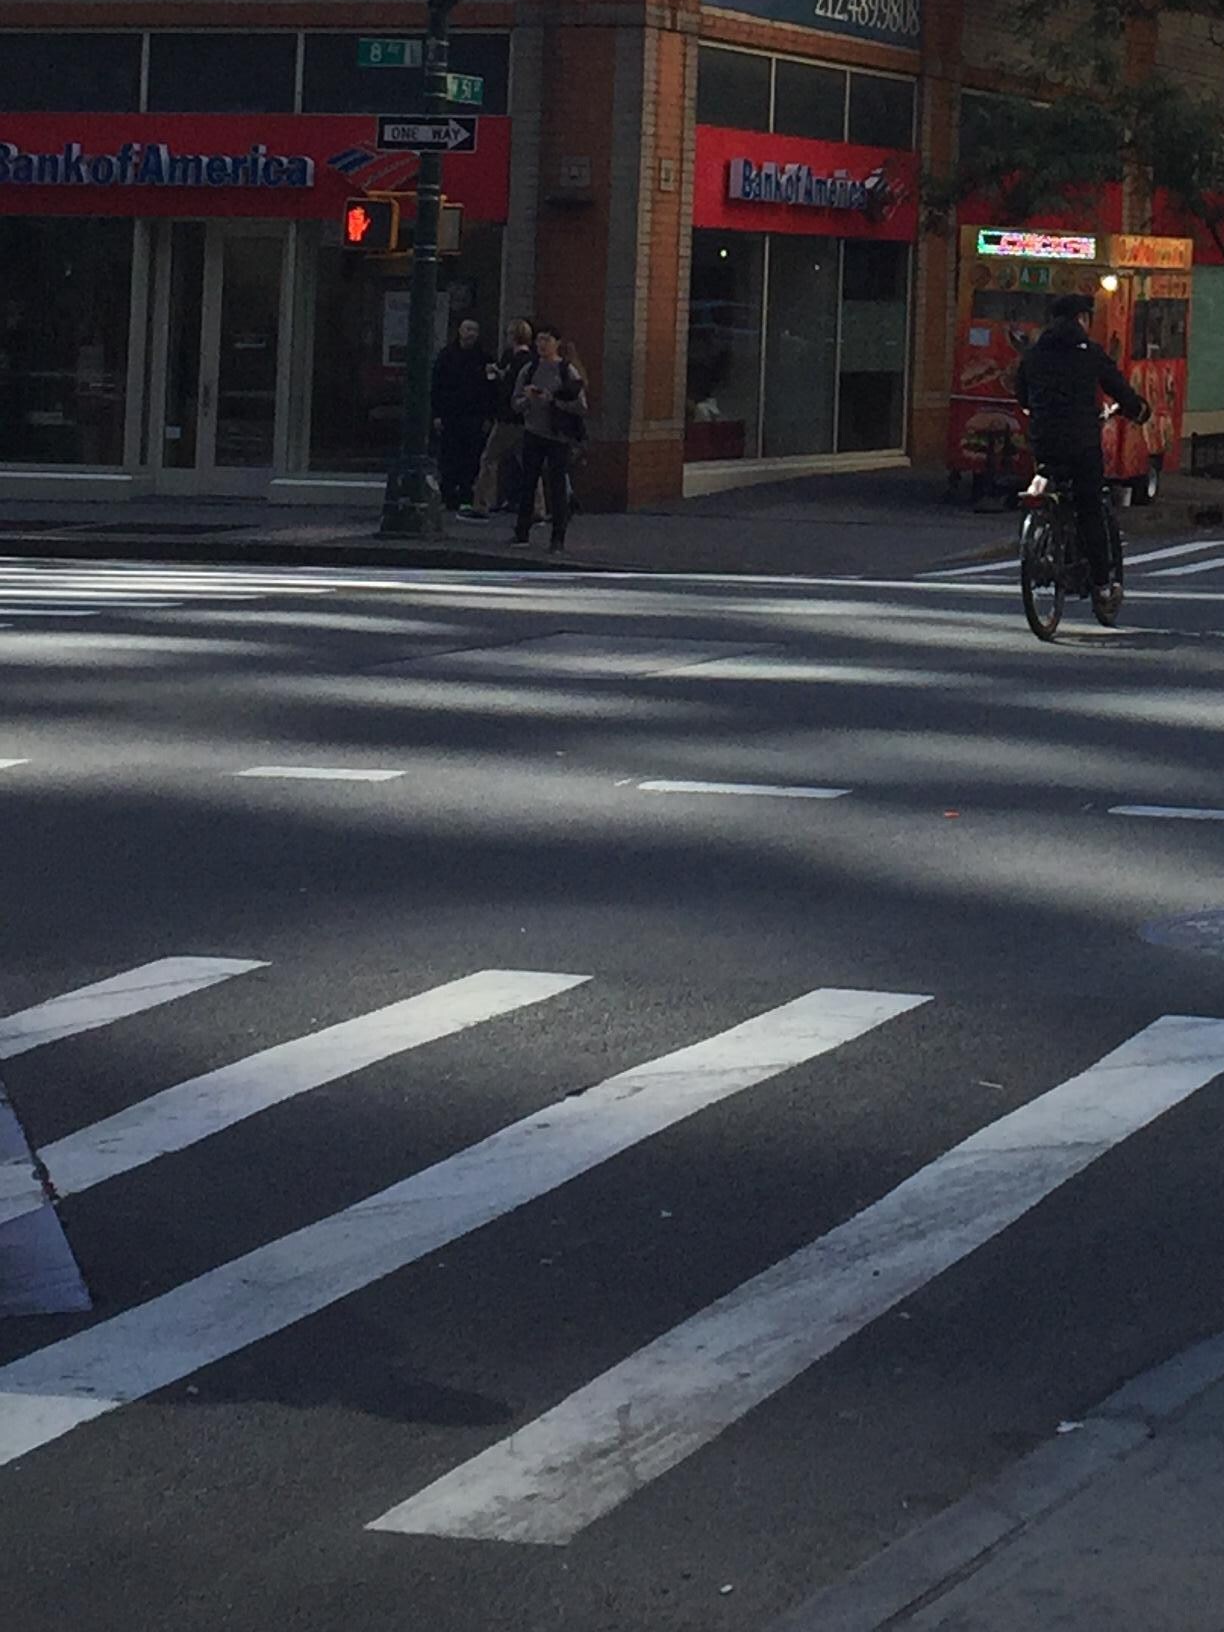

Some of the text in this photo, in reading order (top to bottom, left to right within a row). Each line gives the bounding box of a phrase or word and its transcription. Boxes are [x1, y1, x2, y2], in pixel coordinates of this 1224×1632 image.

[369, 42, 382, 62] 8
[391, 125, 461, 141] ONE WAY
